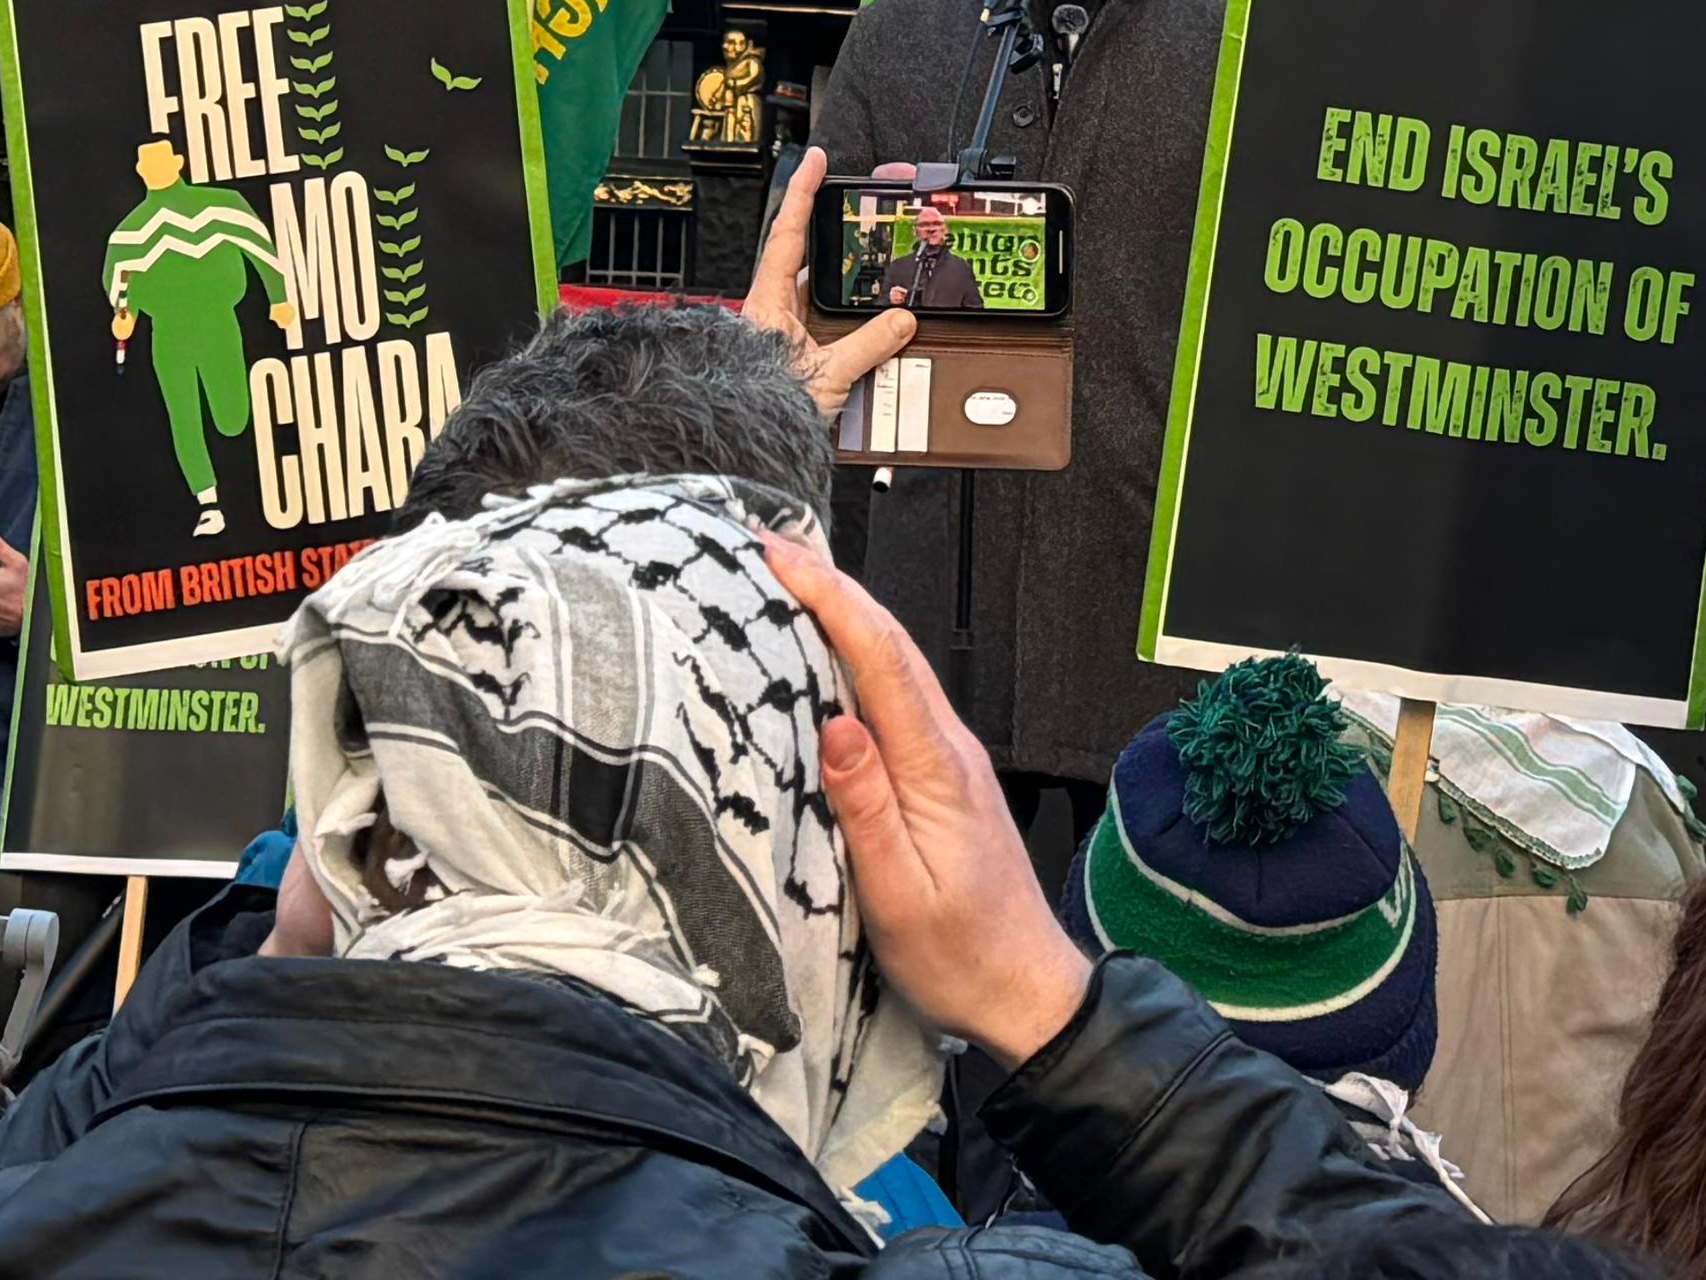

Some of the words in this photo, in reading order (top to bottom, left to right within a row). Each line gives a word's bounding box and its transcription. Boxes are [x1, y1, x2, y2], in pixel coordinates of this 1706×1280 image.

[140, 4, 299, 184] FREE
[1317, 107, 1431, 193] END
[1441, 125, 1674, 226] ISRAEL'S
[272, 171, 380, 350] MO
[1263, 217, 1617, 336] OCCUPATION
[1624, 266, 1695, 345] OF
[1255, 333, 1667, 461] WESTMINSTER.
[86, 568, 175, 621] FROM
[179, 551, 296, 606] BRITISH
[300, 539, 375, 588] STA
[45, 684, 266, 734] WESTMINSTER.
